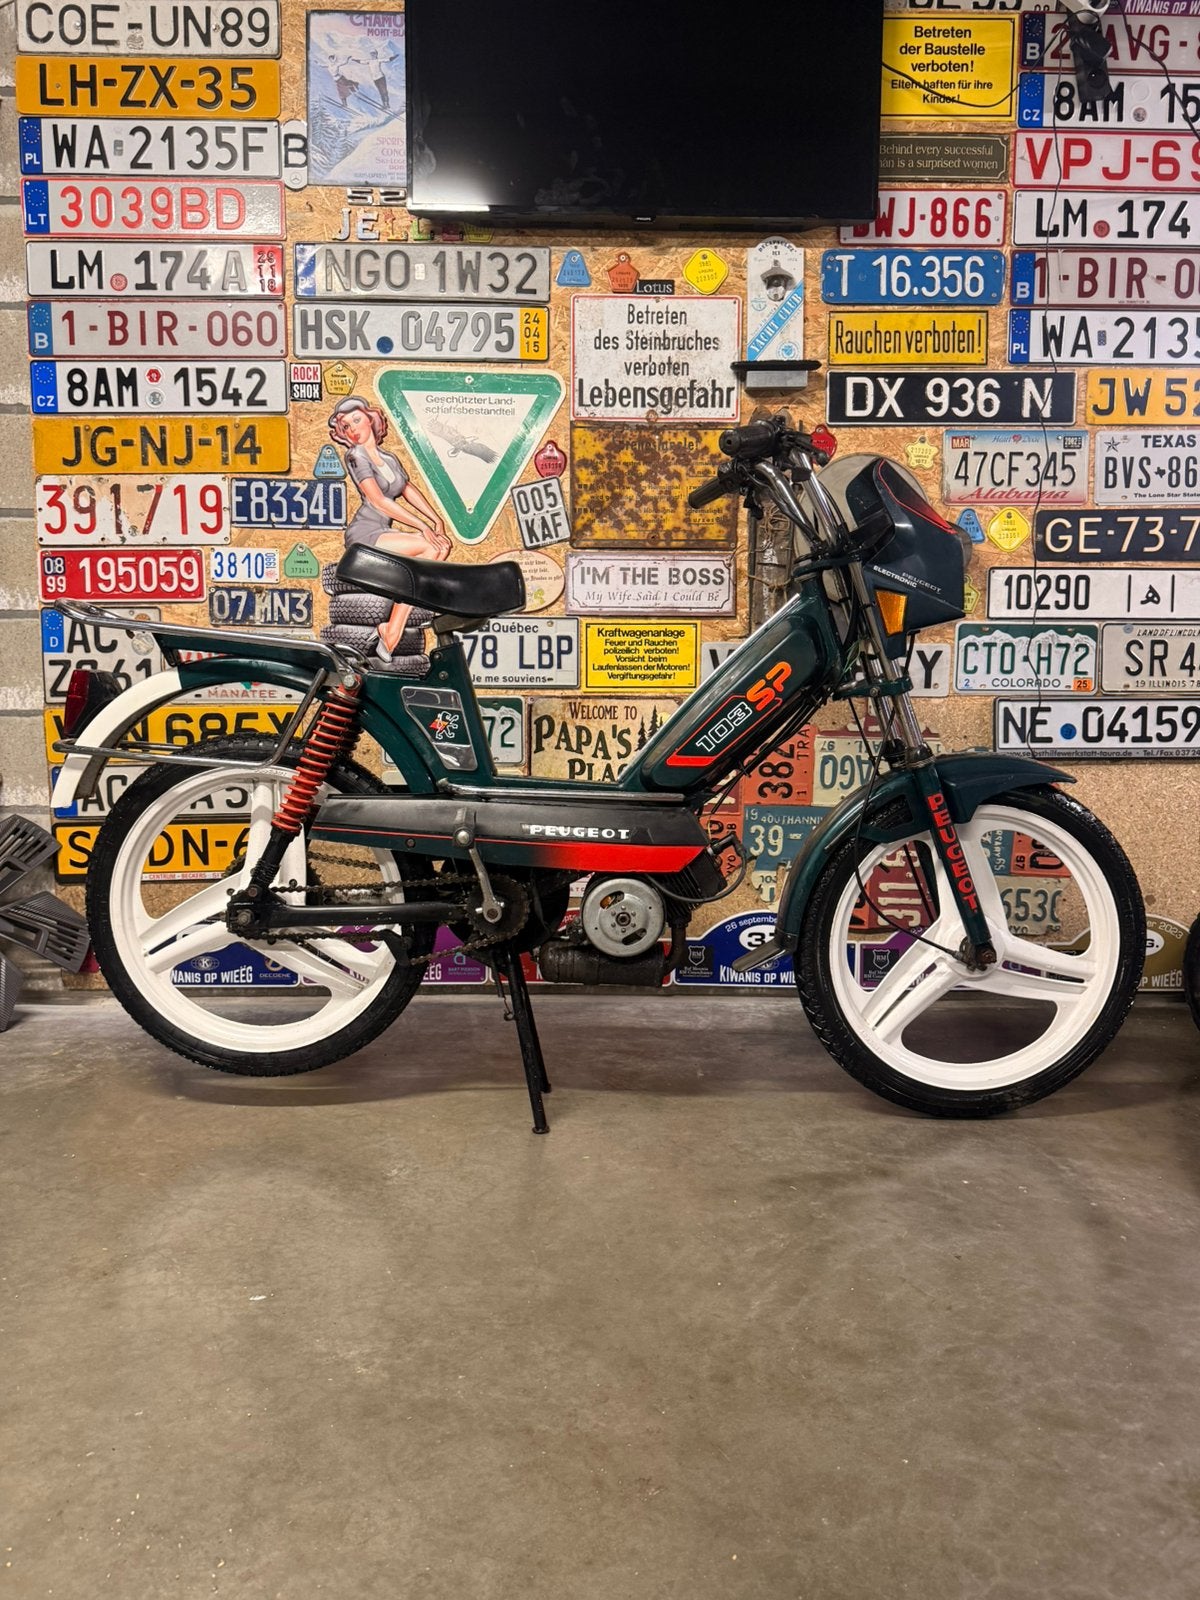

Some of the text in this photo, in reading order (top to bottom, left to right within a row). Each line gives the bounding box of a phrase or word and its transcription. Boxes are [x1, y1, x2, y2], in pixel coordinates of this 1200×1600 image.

[1172, 2, 1187, 14] OP
[914, 26, 972, 38] Betreten
[899, 43, 985, 55] der Baustelle
[1026, 43, 1040, 60] B
[911, 60, 974, 73] verboten!
[39, 63, 257, 110] LH-ZX-35
[891, 79, 993, 90] Eltern haften für ihre
[923, 94, 960, 104] Kinder!
[1023, 108, 1041, 121] CZ
[52, 123, 270, 172] WA 2135F
[283, 135, 308, 168] B
[880, 144, 993, 157] Behind every successful
[25, 152, 41, 166] PL
[897, 158, 998, 170] is a surprised women
[60, 186, 246, 231] 3039BD
[27, 213, 46, 226] LT
[1036, 199, 1191, 239] LM 174
[51, 249, 248, 291] LM 174A
[324, 249, 410, 292] NGO
[432, 250, 537, 295] 1W32
[835, 255, 985, 298] T 16.356
[1016, 282, 1030, 298] B
[523, 312, 540, 325] 24
[627, 303, 687, 325] Betreten
[750, 293, 803, 353] YACHT CLUB
[61, 310, 278, 347] 1-BIR-060
[300, 309, 514, 352] HSK 04795
[523, 326, 540, 339] 04
[835, 317, 982, 354] Rauchen verboten!
[1042, 315, 1093, 358] WA
[34, 333, 49, 350] B
[524, 341, 540, 353] 15
[593, 328, 720, 352] des Steinbruches
[1012, 342, 1028, 354] PL
[293, 366, 319, 380] ROCK
[624, 354, 690, 376] verboten
[66, 367, 268, 408] 8AM 1542
[293, 383, 320, 399] SHOX
[578, 378, 735, 414] Lebensgefahr
[1092, 377, 1152, 416] JW
[36, 395, 56, 407] CZ
[425, 394, 487, 406] Geschützter
[845, 376, 1053, 418] DX 936 N
[425, 405, 516, 417] schaftsbestandteil
[61, 424, 262, 467] JG-NJ-14
[953, 438, 970, 448] MAR
[1141, 434, 1197, 449] TEXAS
[955, 451, 1077, 487] 47CF345
[1104, 456, 1151, 489] BVS
[231, 480, 347, 524] E83340
[958, 486, 1070, 501] Alabama
[42, 483, 223, 536] 391719
[525, 511, 563, 545] KAF
[43, 556, 65, 575] 08
[214, 551, 265, 579] 3810
[78, 556, 199, 593] 195059
[580, 566, 611, 586] I'M
[619, 566, 659, 586] THE
[668, 567, 725, 586] BOSS
[873, 565, 918, 588] ELECTRONIC
[46, 576, 67, 593] 99
[1004, 574, 1090, 611] 10290
[585, 591, 603, 605] My
[607, 590, 633, 605] Wife
[637, 590, 661, 601] Said
[664, 592, 668, 601] I
[672, 590, 702, 602] Could
[491, 621, 539, 634] Québec
[597, 627, 686, 638] Kraftwagenanlage
[49, 636, 59, 648] D
[603, 647, 680, 655] polizeilich verboten!
[604, 639, 678, 647] Feuer und Rauchen
[518, 634, 573, 670] LBP
[615, 655, 668, 663] Vorsicht beim
[1125, 639, 1169, 677] SR
[485, 675, 500, 683] me
[502, 674, 547, 683] souviens
[607, 672, 676, 681] Vergiftungsgefahr!
[991, 677, 1061, 689] COLORADO
[1076, 680, 1088, 689] 25
[1135, 680, 1146, 688] 19
[1148, 680, 1187, 688] ILLINOIS
[207, 689, 278, 699] MANATEE
[568, 701, 638, 720] WELCOME TO
[695, 661, 792, 752] 103 SP
[1003, 706, 1053, 743] NE
[533, 714, 632, 761] PAPA'S
[529, 824, 630, 840] PEUGEOT
[927, 793, 978, 913] PEUGEOT
[725, 921, 738, 933] 26
[1158, 921, 1184, 940] 2023
[204, 965, 253, 984] OP WIEËG
[719, 964, 761, 984] KIWANIS
[764, 972, 777, 984] OP
